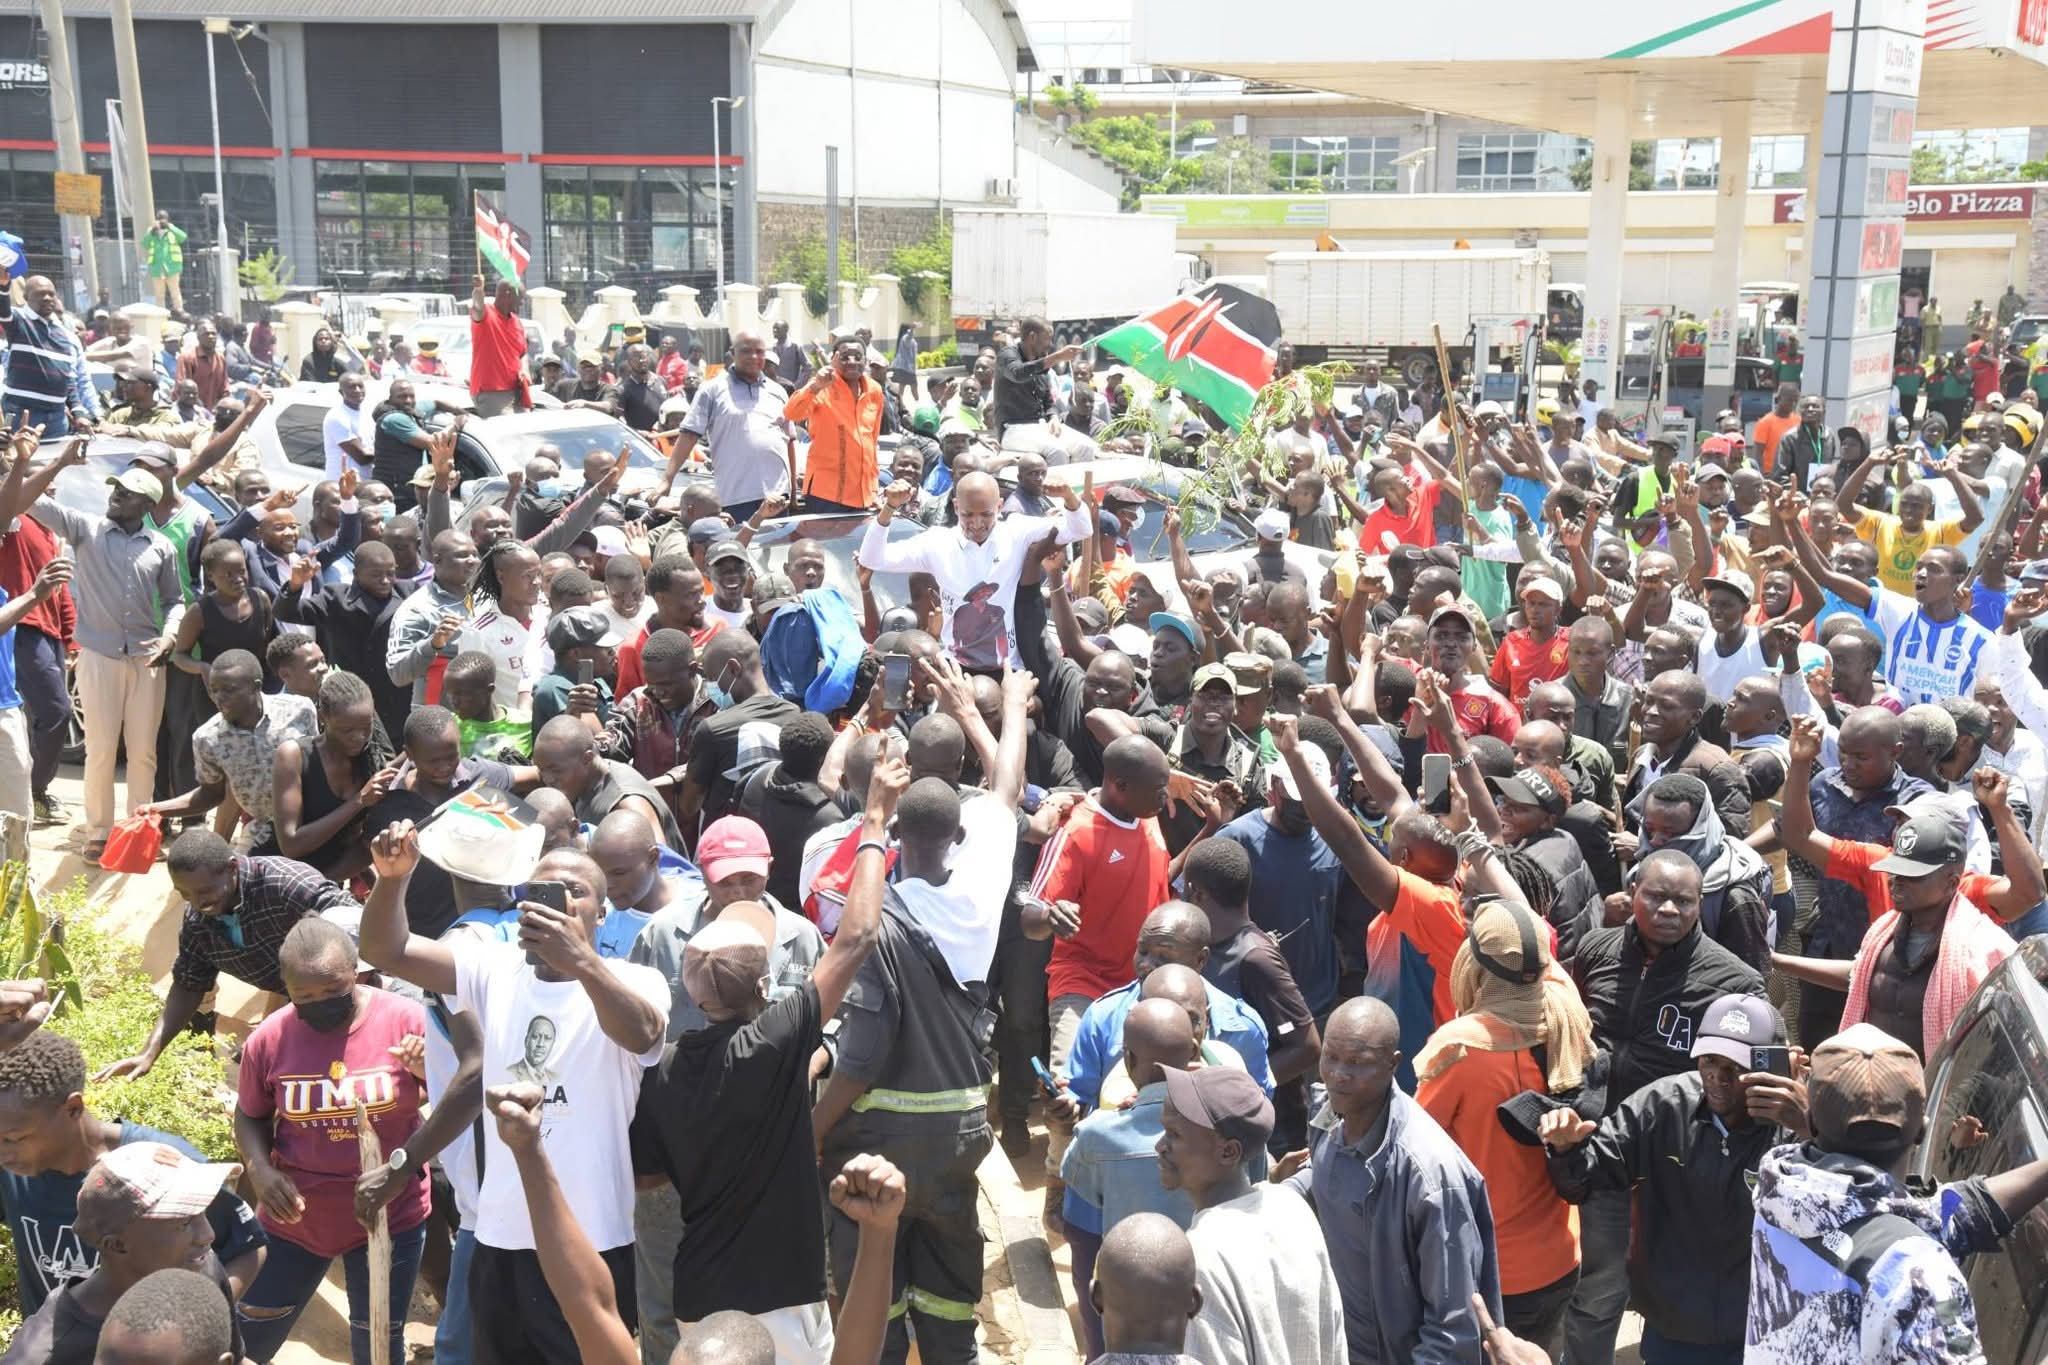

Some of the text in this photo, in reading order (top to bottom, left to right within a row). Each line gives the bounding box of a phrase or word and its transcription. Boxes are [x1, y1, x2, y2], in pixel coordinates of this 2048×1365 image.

[0, 63, 48, 82] ORS
[1949, 192, 2024, 213] Pizza
[281, 1072, 394, 1114] UMD
[301, 1114, 379, 1129] BULLDOS
